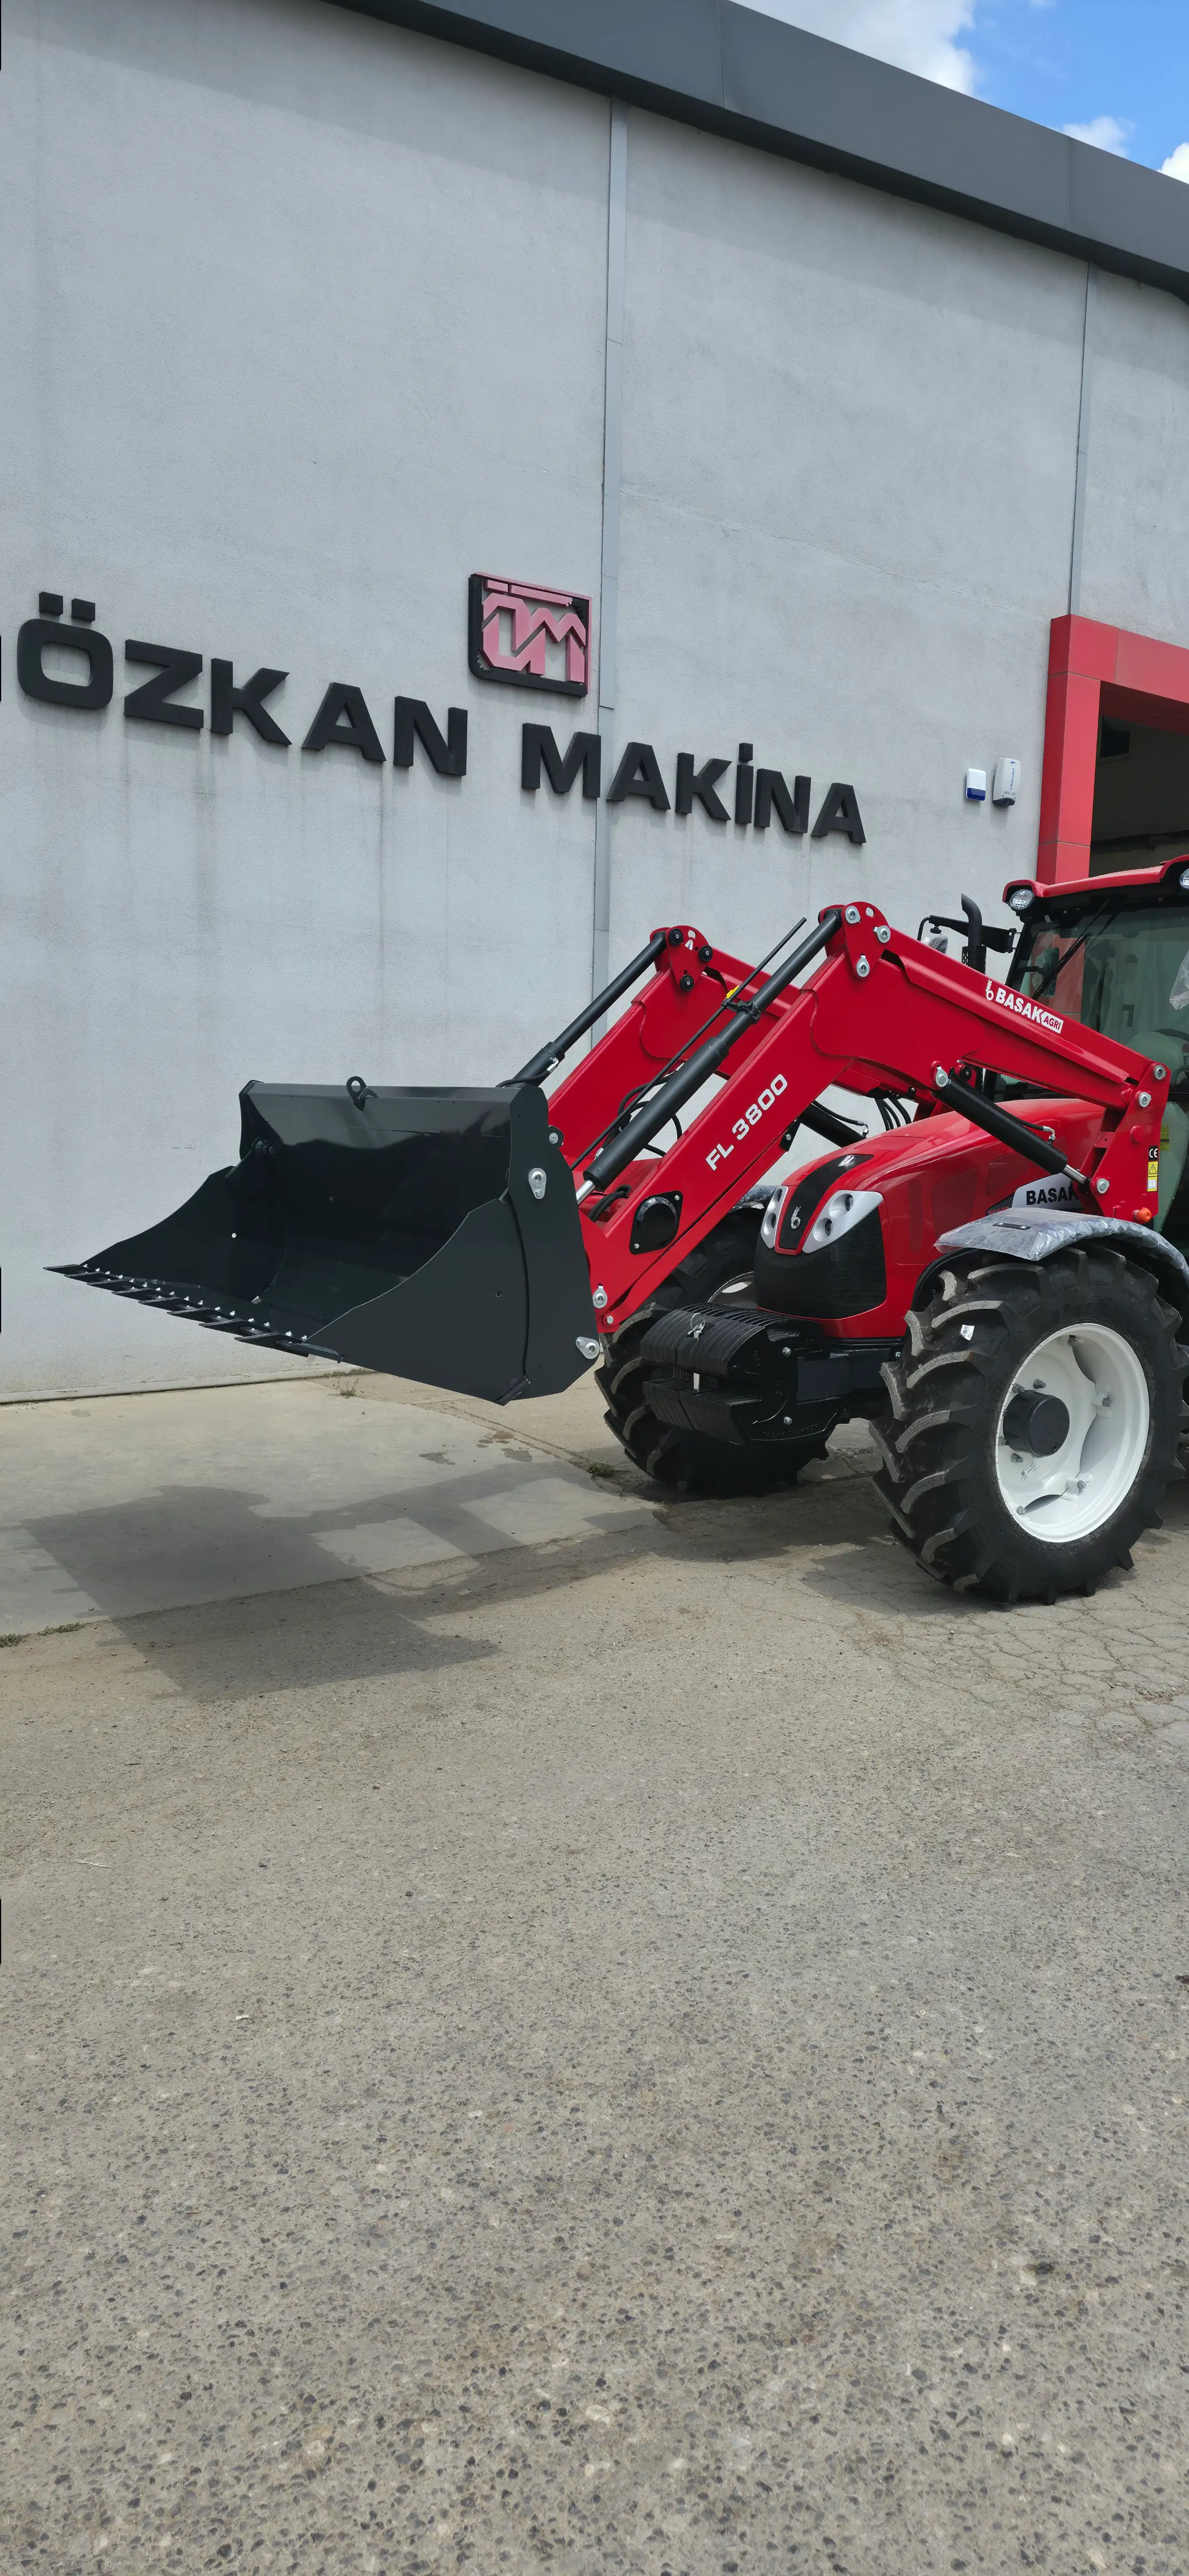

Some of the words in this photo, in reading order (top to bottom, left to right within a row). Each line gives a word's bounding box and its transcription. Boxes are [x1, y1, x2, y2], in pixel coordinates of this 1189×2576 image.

[17, 590, 468, 777] ÖZKAN
[521, 722, 867, 844] MAKİNA
[1043, 1016, 1061, 1030] AGRI
[705, 1143, 734, 1171] FL
[732, 1074, 788, 1140] 3800
